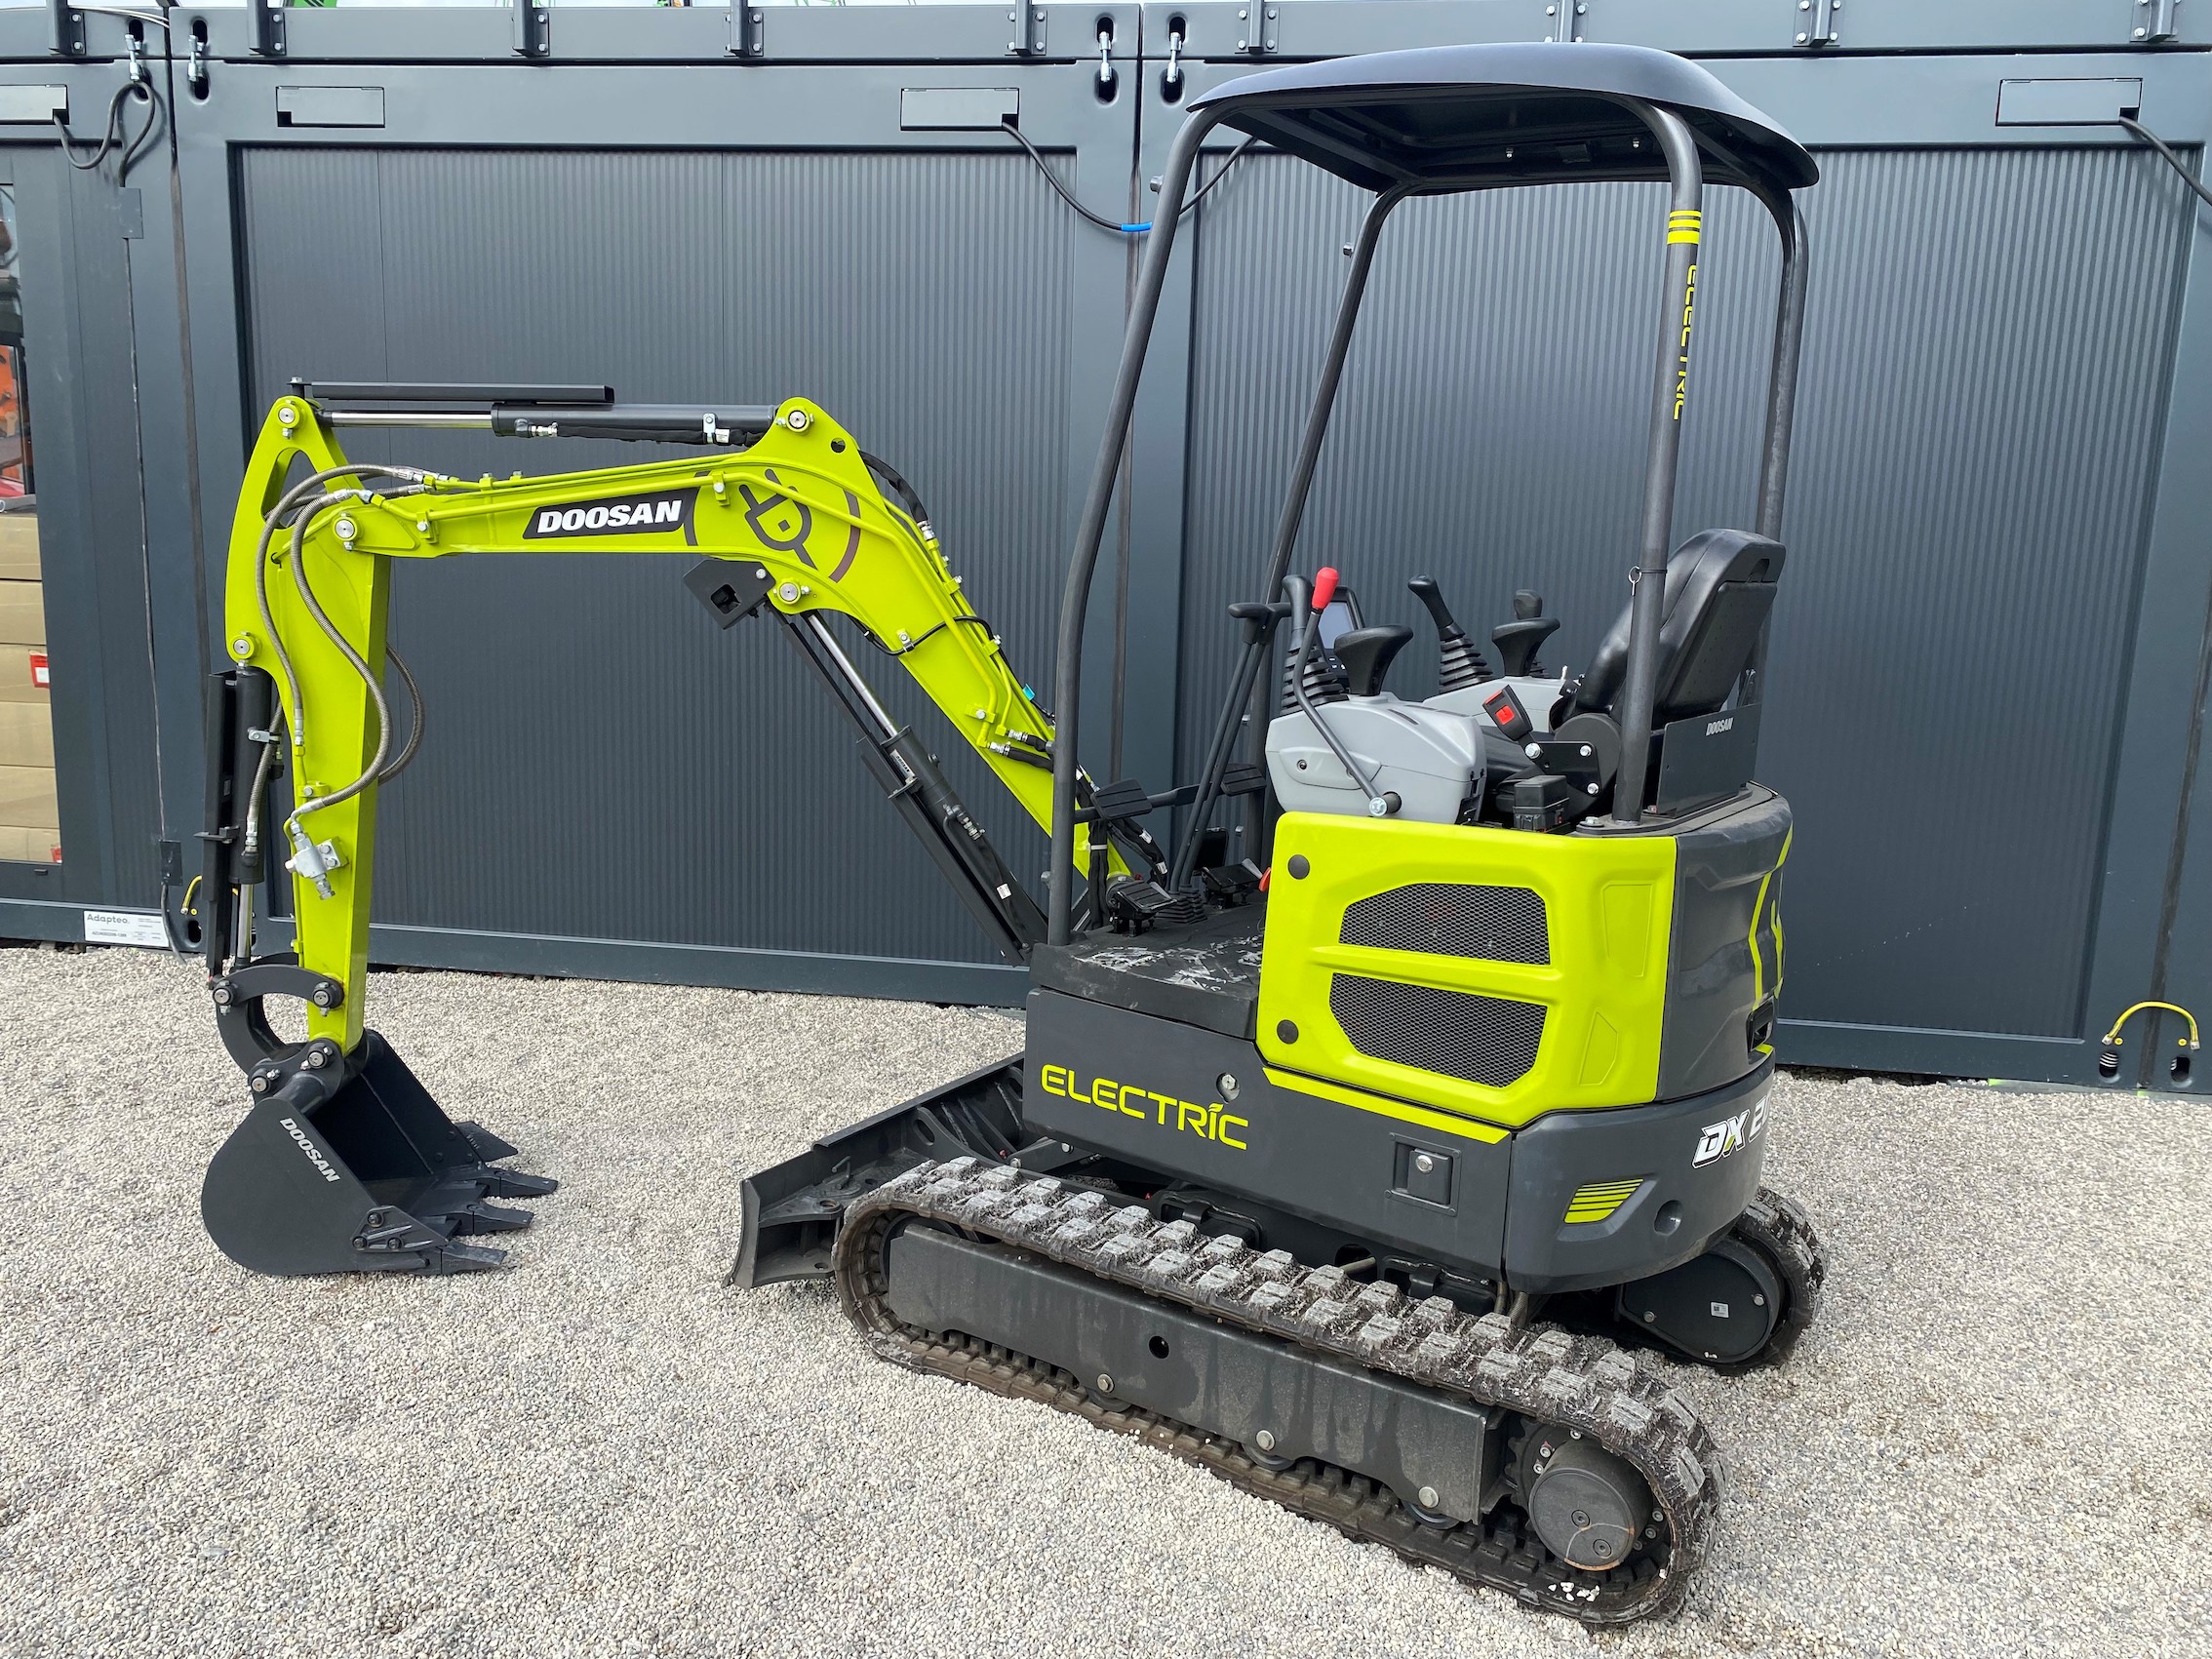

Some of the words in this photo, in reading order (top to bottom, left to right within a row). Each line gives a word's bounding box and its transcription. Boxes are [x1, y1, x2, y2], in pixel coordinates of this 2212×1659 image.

[536, 499, 683, 533] DOOSAN
[1706, 717, 1734, 736] DOOSAN
[87, 913, 128, 925] Adapteo
[1041, 1064, 1249, 1151] ELECTRIC
[279, 1118, 340, 1182] DOOSAN
[1691, 1108, 1751, 1169] DX
